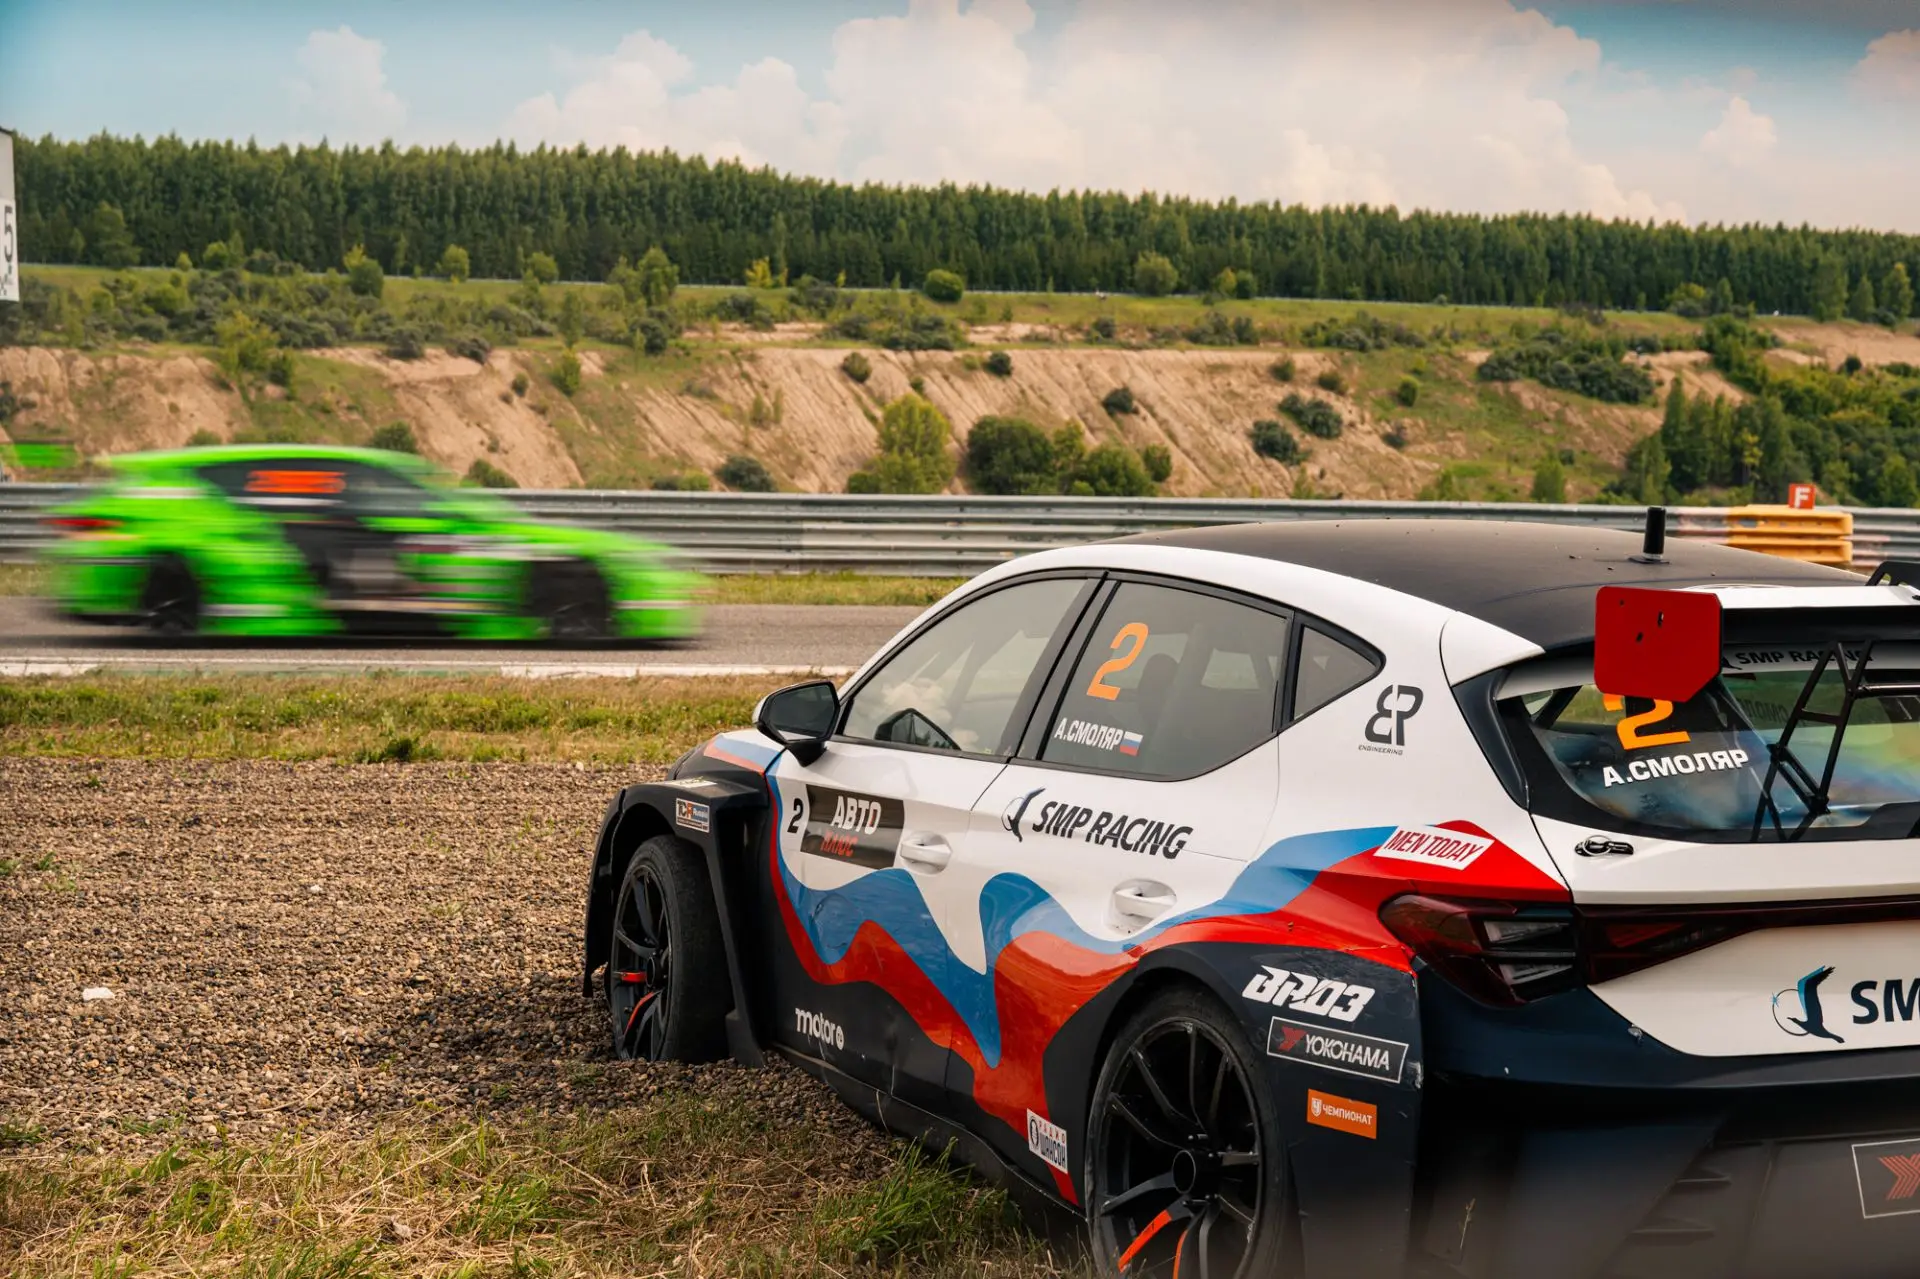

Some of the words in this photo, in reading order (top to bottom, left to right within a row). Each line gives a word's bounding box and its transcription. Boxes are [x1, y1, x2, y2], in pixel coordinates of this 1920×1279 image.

[1794, 486, 1810, 507] F
[1086, 622, 1149, 700] 2
[1735, 651, 1785, 665] SMP
[1055, 717, 1123, 751] А.СМОЛЯР
[1358, 744, 1404, 756] ENGINEERING
[1602, 749, 1749, 787] А.СМОЛЯР
[787, 797, 804, 834] 2
[830, 795, 882, 835] АВТО
[1032, 800, 1094, 837] SMP
[1089, 810, 1193, 860] RACING
[1384, 830, 1431, 853] MEN
[1420, 836, 1484, 862] TODAY
[1306, 1033, 1390, 1071] YOKOHAMA
[1322, 1103, 1373, 1126] ЧЕМПИОНАТ
